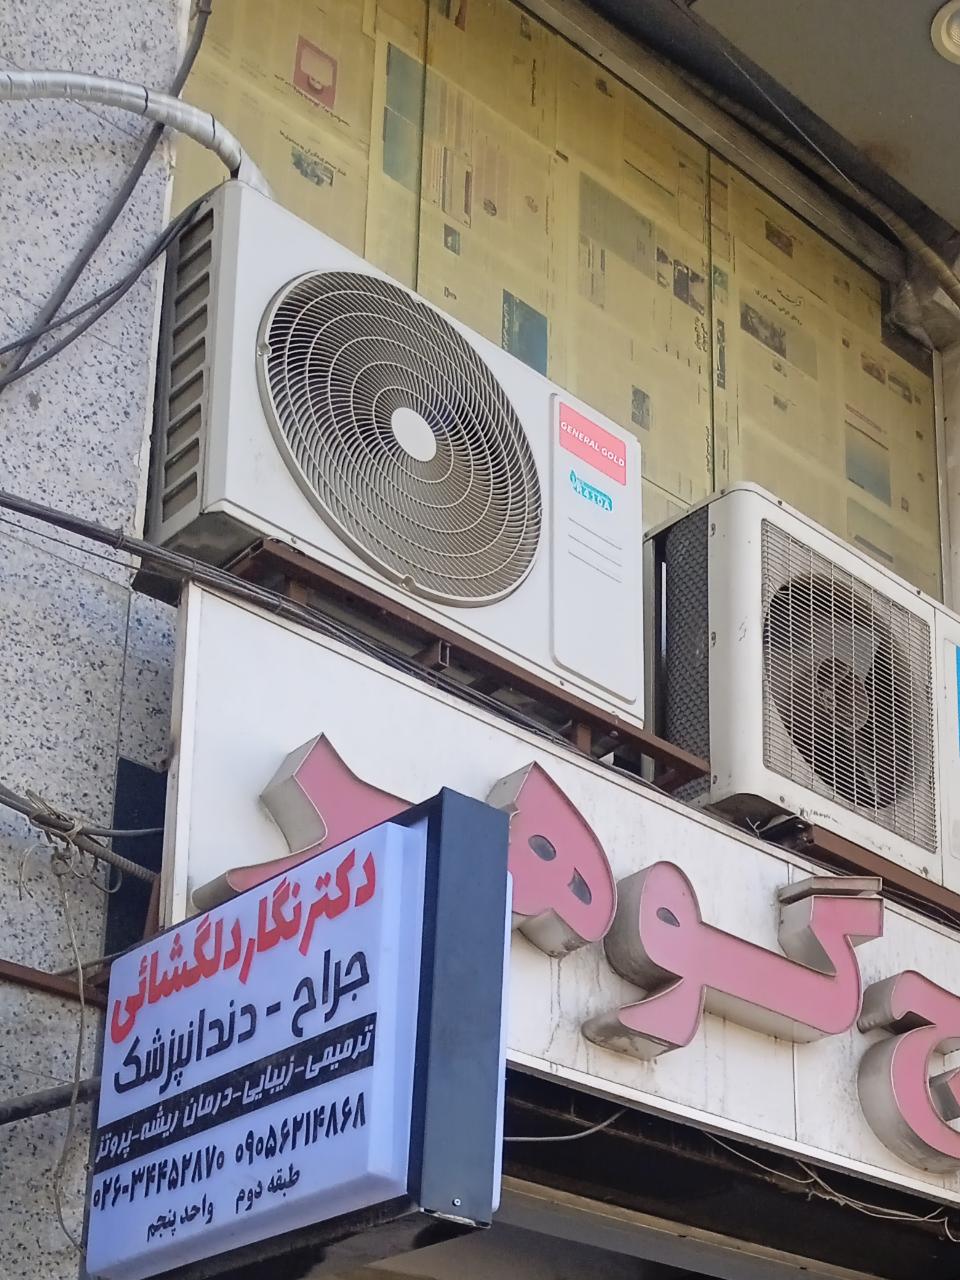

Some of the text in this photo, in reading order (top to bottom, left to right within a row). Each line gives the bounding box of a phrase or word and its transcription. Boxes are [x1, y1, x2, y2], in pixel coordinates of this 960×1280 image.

[560, 421, 625, 467] GENERAL GOLD
[239, 876, 302, 985] نگار
[299, 847, 377, 957] دکتر
[291, 948, 371, 1038] جراح
[113, 998, 257, 1095] دندانپزشک
[147, 1163, 301, 1243] طبقه دوم واحد پنجم
